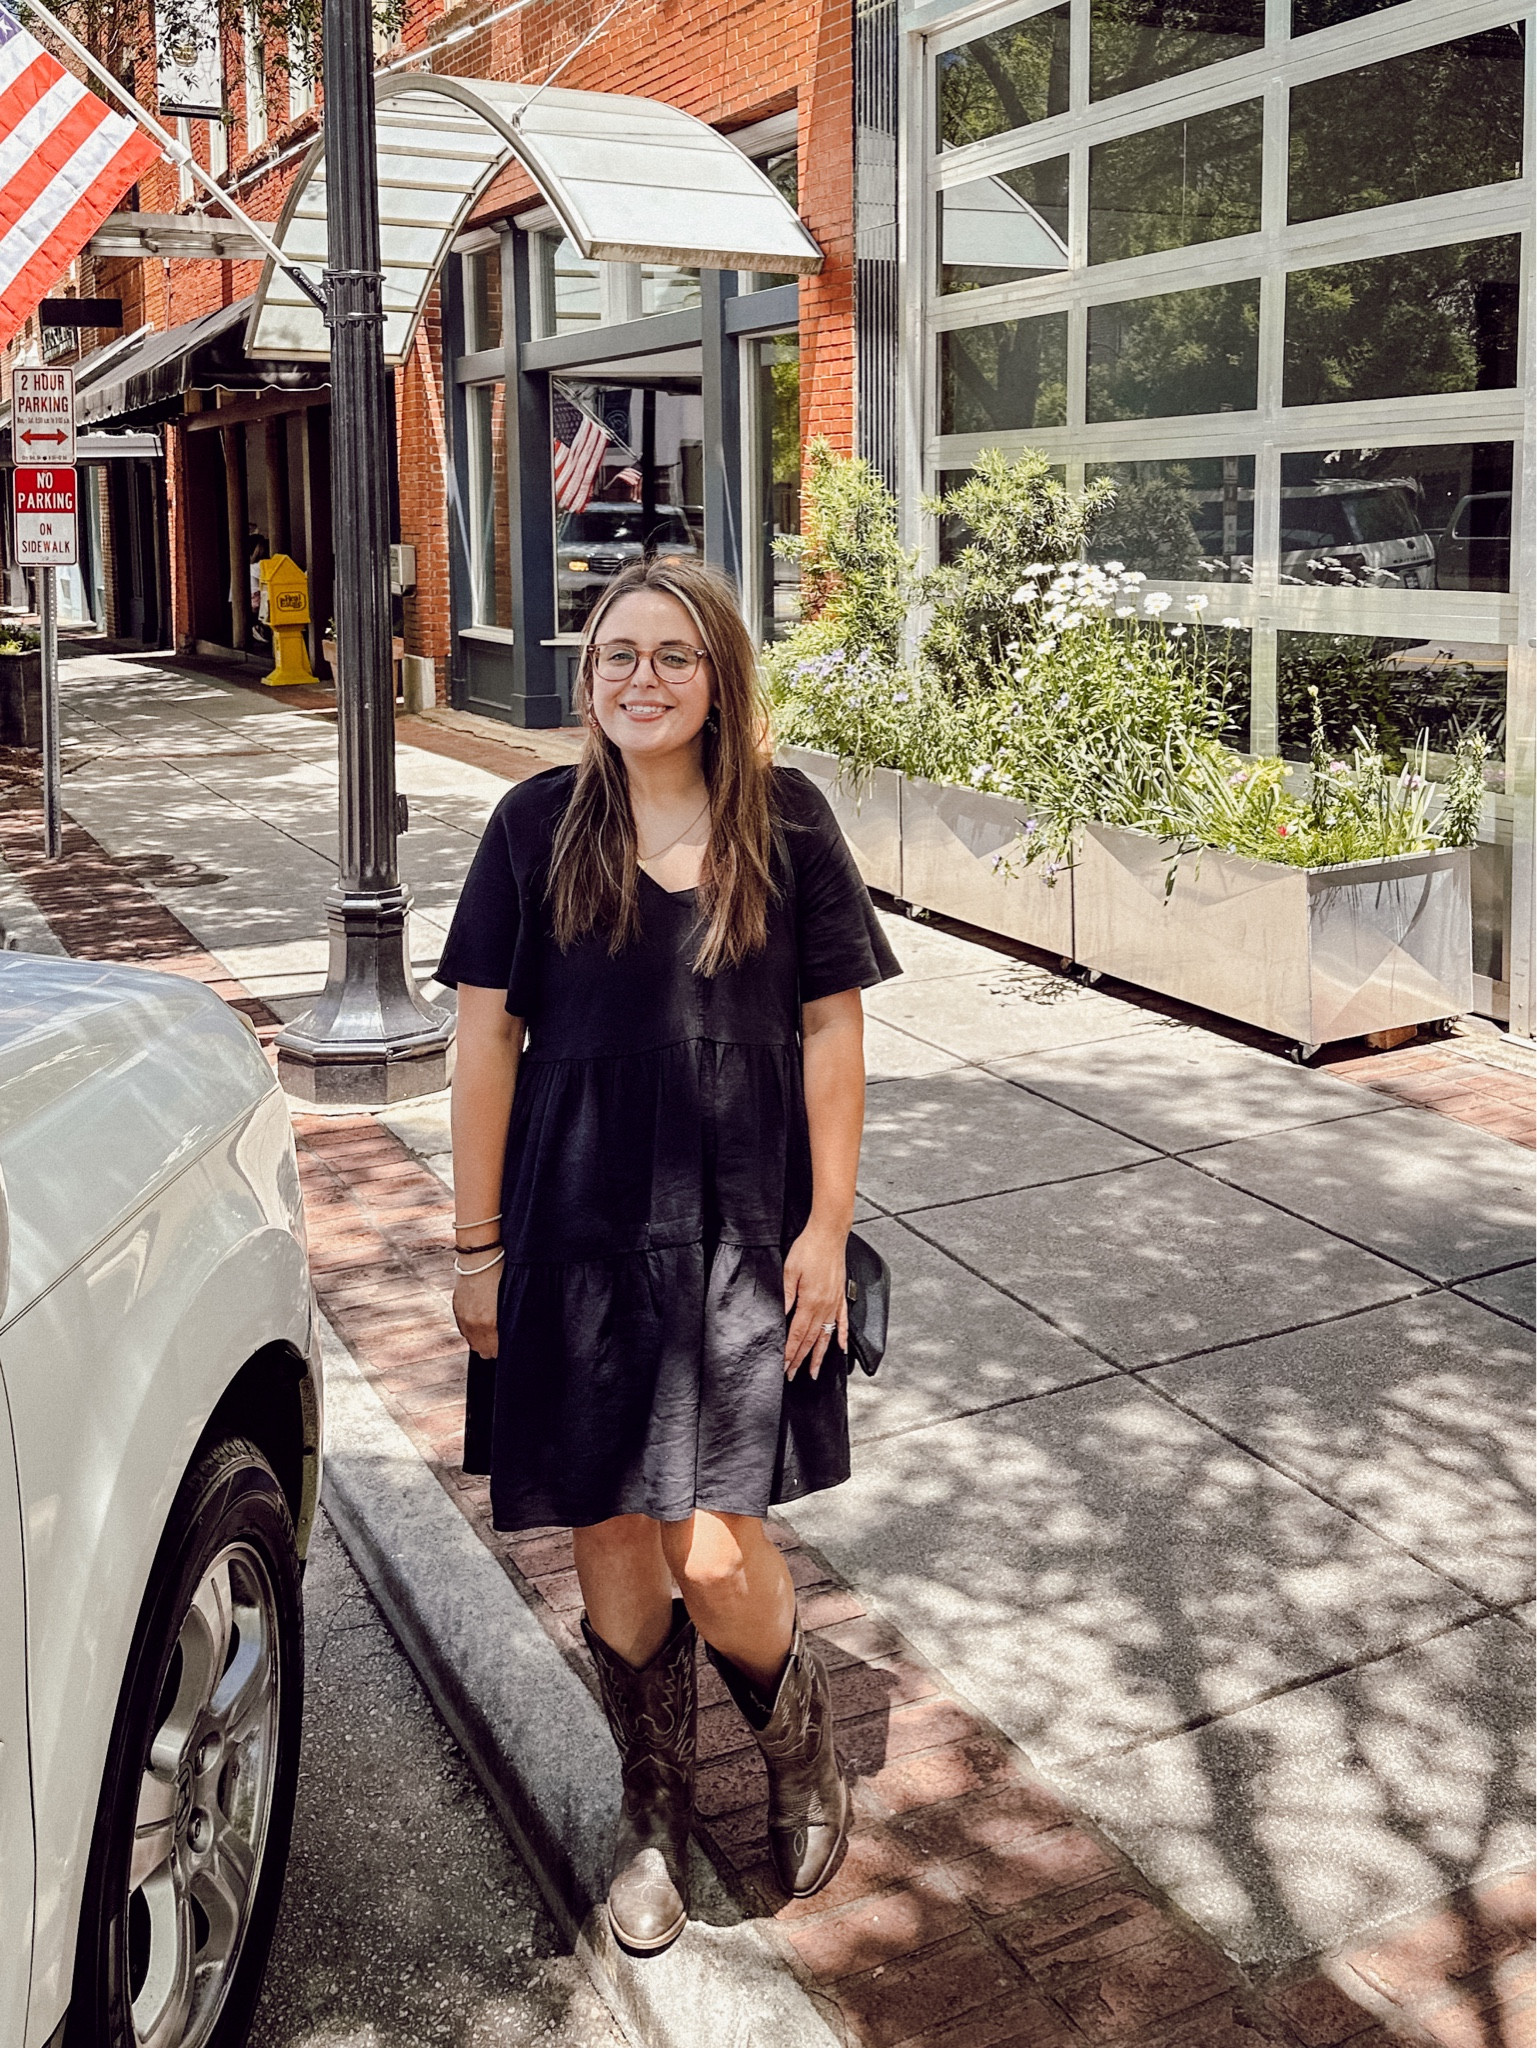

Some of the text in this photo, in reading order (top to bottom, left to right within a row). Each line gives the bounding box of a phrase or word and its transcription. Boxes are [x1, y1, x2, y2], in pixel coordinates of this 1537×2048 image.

[21, 374, 65, 391] 2 HOUR
[18, 396, 69, 413] PARKING
[36, 472, 53, 489] NO
[18, 492, 73, 510] PARKING
[40, 523, 52, 536] ON
[22, 540, 70, 553] SIDEWALK
